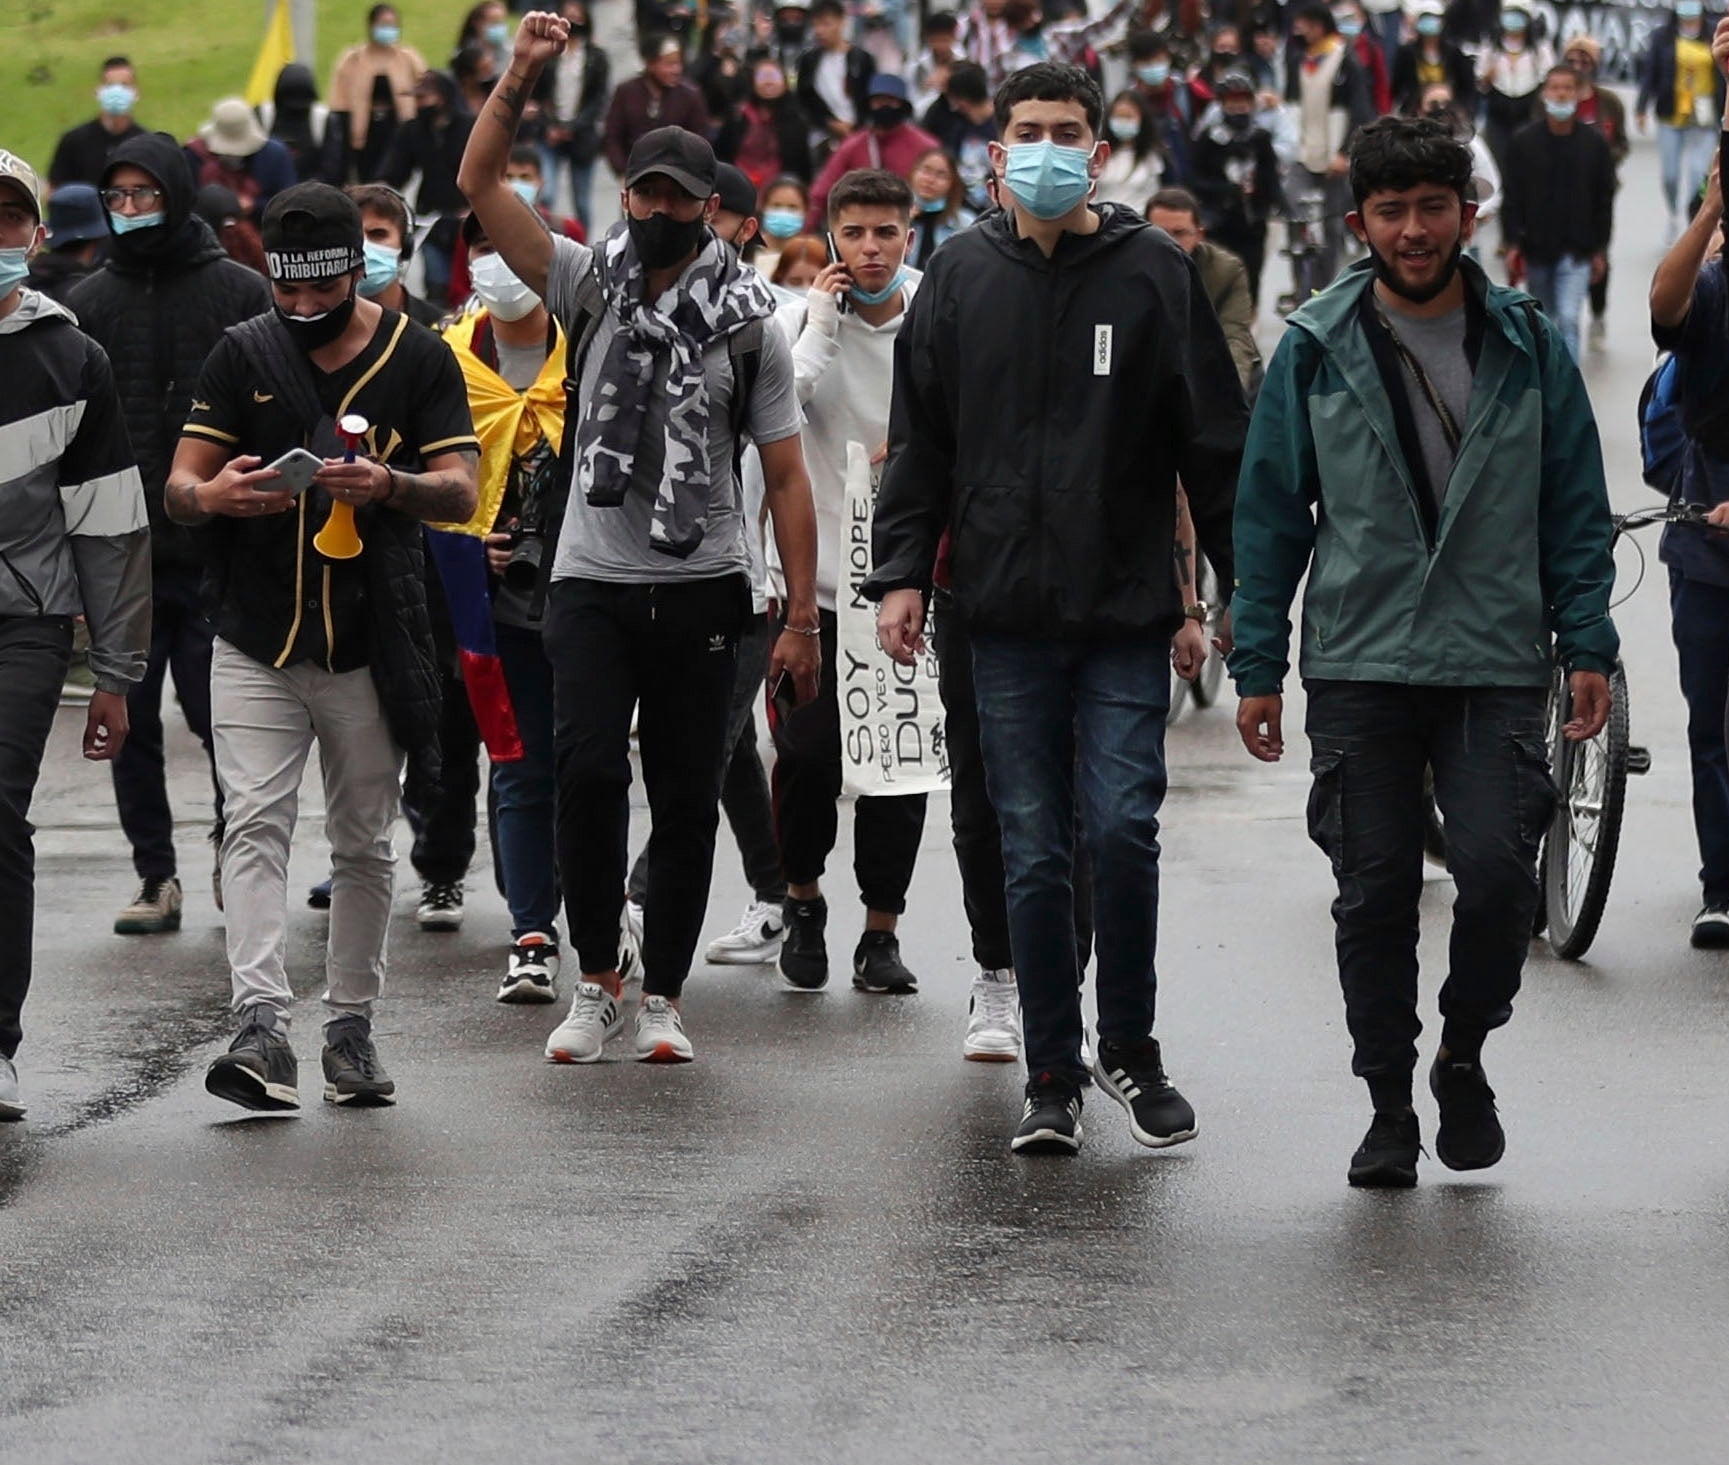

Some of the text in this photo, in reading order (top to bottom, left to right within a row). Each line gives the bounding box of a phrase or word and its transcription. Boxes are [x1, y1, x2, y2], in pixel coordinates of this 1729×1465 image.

[282, 258, 349, 280] TRIBUTARIA
[291, 253, 305, 264] LA
[307, 246, 349, 262] REFORMA
[845, 498, 874, 766] SOY MIOPE
[875, 667, 889, 713] VEO
[878, 724, 896, 783] PERO
